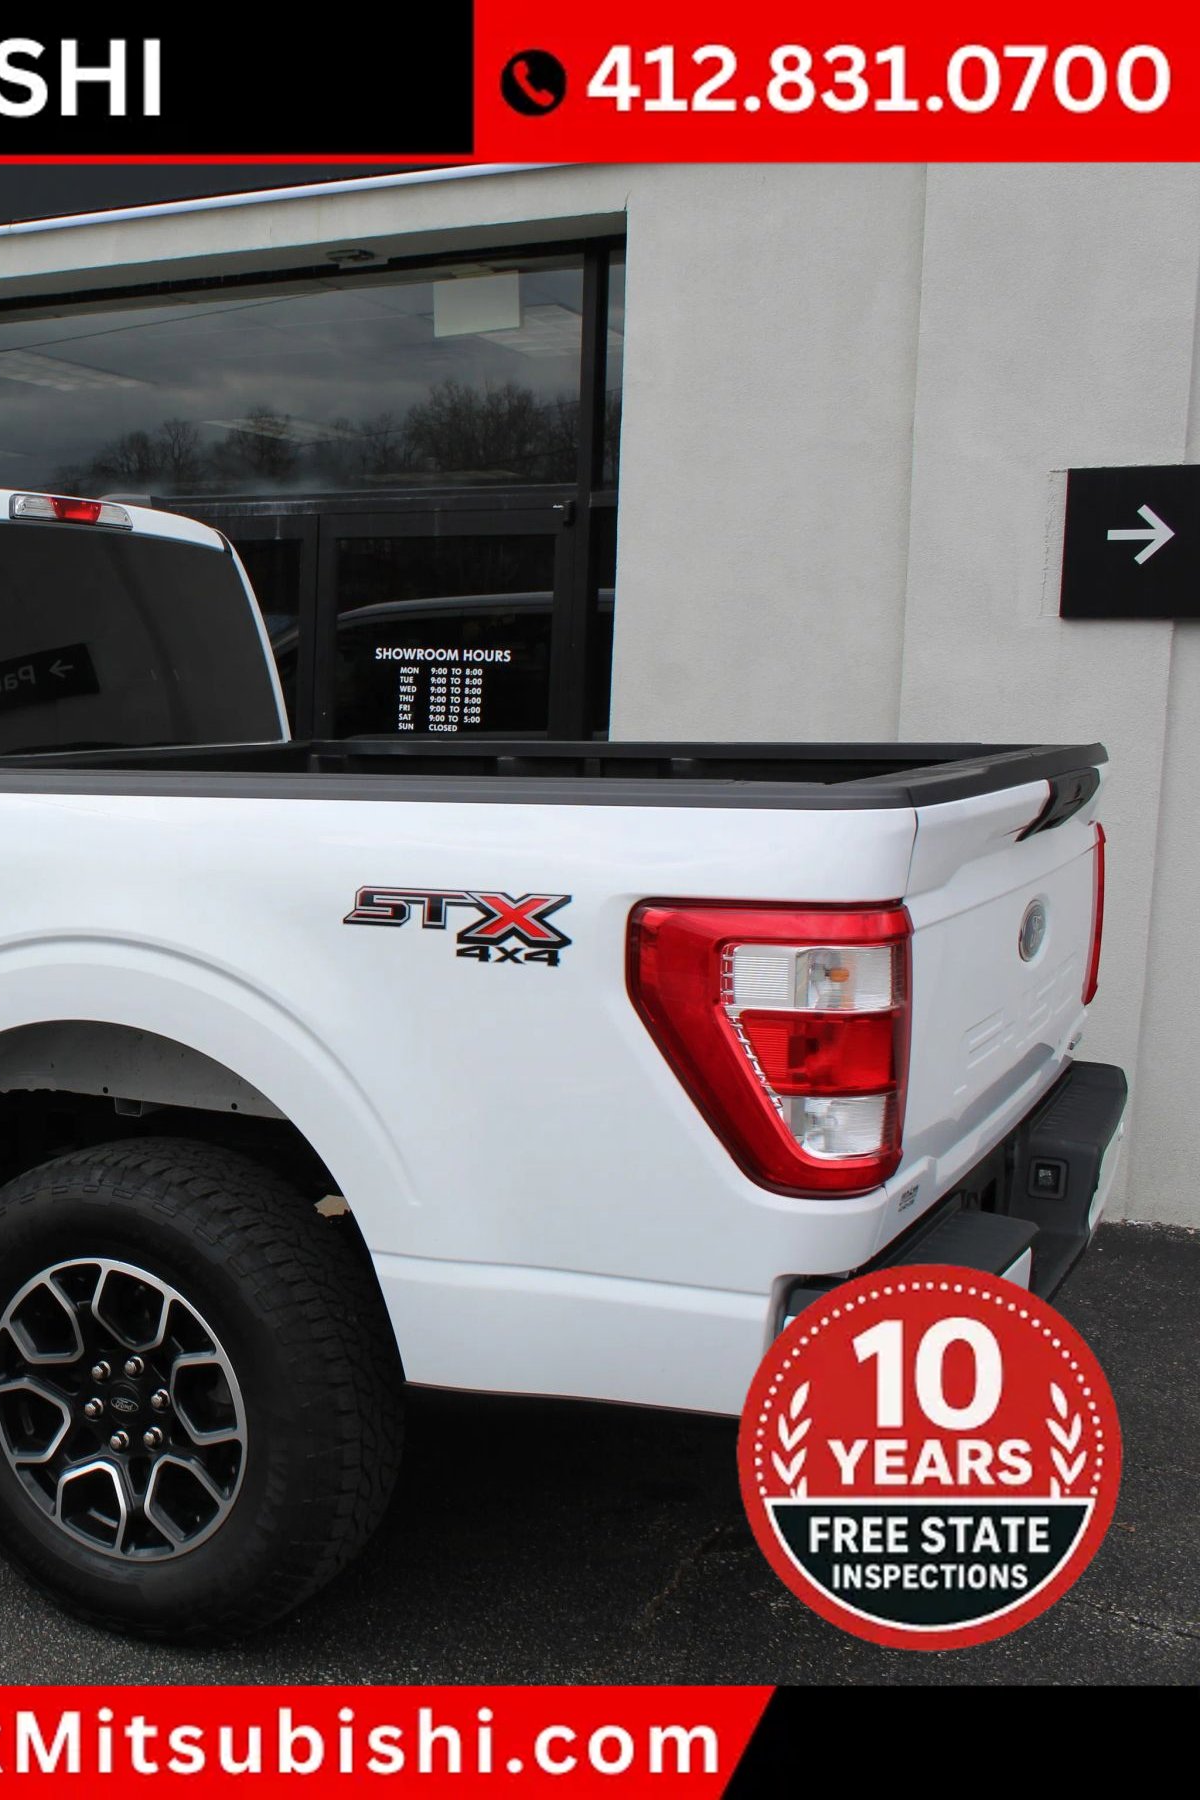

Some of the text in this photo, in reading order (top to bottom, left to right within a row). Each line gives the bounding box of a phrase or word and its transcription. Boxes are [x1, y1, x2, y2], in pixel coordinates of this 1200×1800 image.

[375, 647, 511, 662] SHOWROOM HOURS
[431, 667, 448, 675] 9:00
[465, 668, 483, 676] 8:00
[450, 677, 461, 685] TO
[399, 685, 417, 693] WED
[430, 686, 447, 694] 9:00
[464, 687, 482, 695] 8:00
[399, 694, 414, 702] THU
[450, 696, 461, 704] TO
[429, 705, 446, 713] 9:00
[463, 706, 481, 714] 6:00
[428, 714, 445, 722] 9:00
[448, 715, 459, 723] TO
[428, 724, 458, 732] CLOSED
[343, 886, 572, 949] STX
